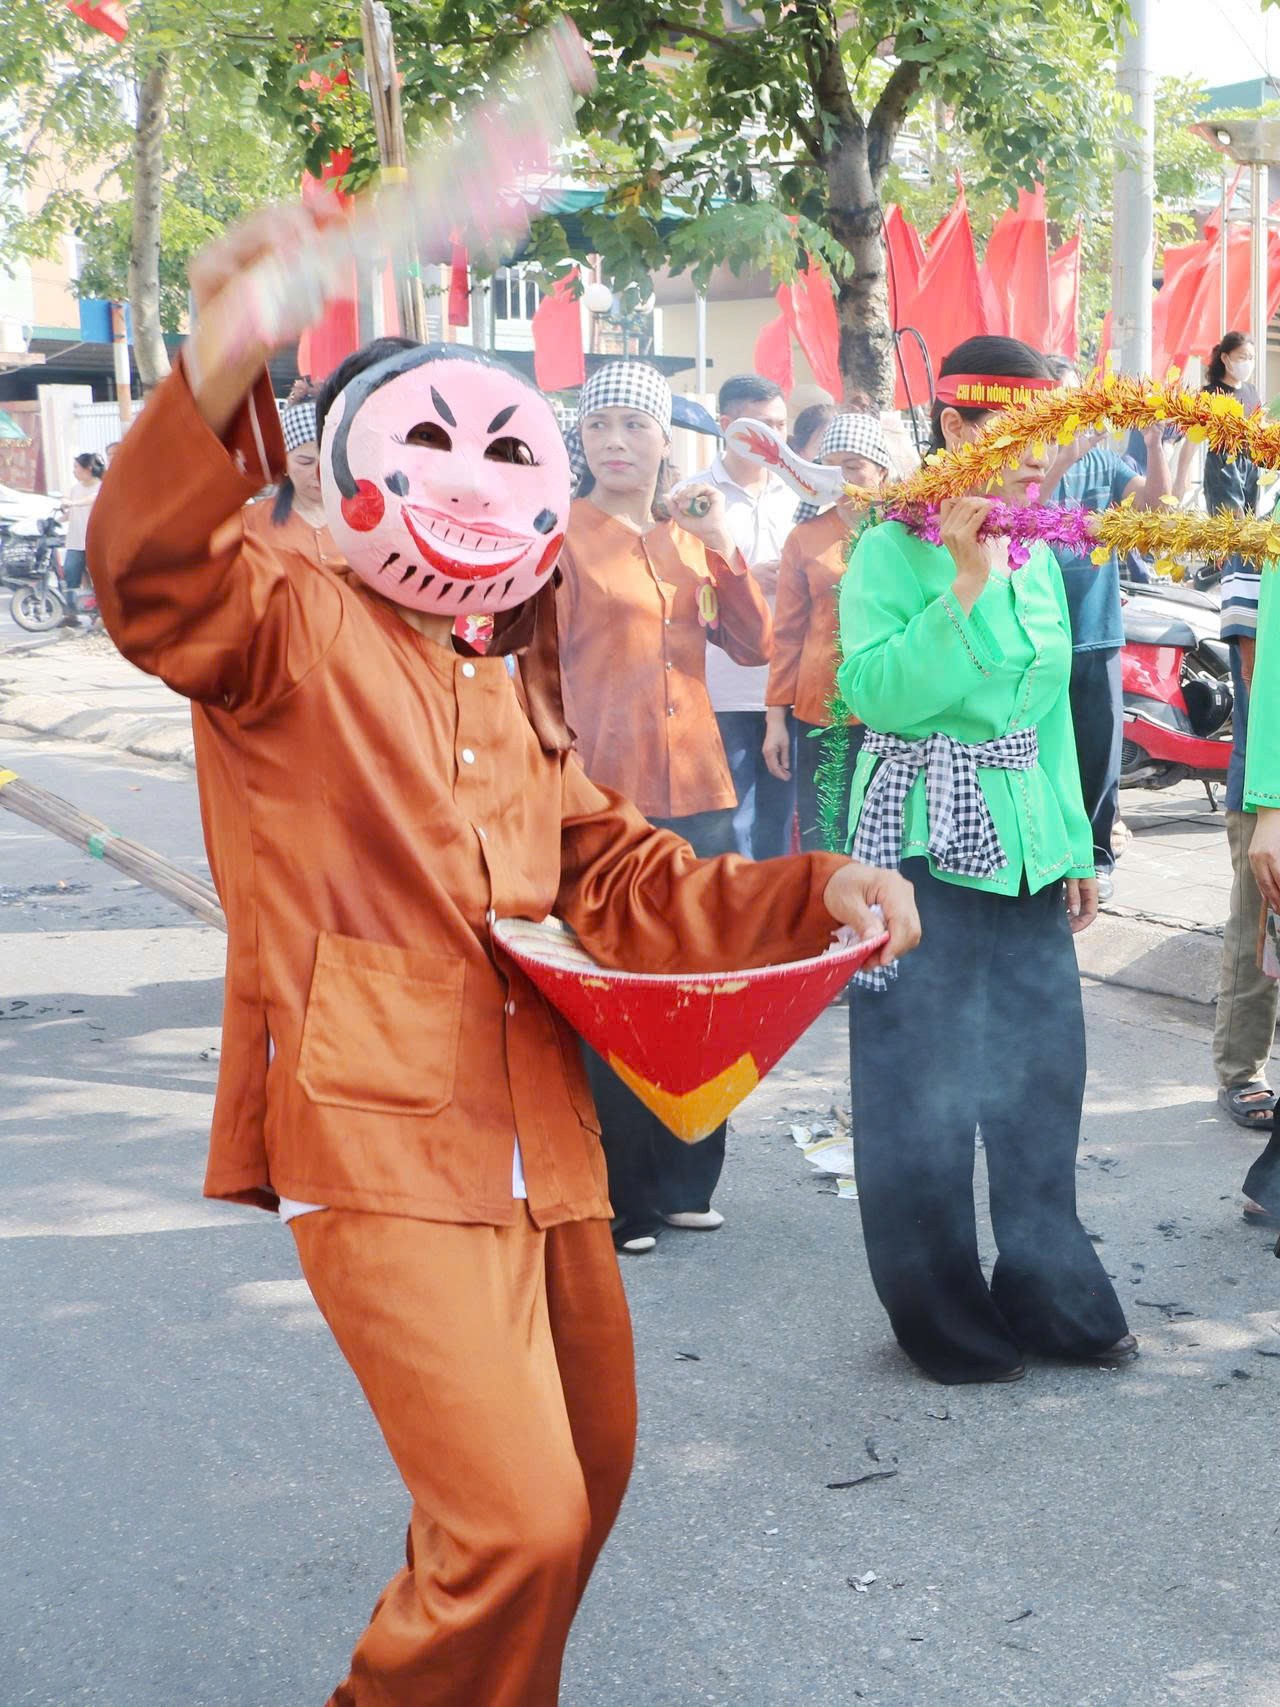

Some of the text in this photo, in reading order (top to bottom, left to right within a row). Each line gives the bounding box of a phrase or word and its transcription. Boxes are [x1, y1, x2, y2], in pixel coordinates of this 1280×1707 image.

[956, 384, 970, 401] CHI
[971, 382, 985, 404] HỘI
[986, 382, 1012, 403] NÔNG
[1013, 385, 1032, 405] DÂN
